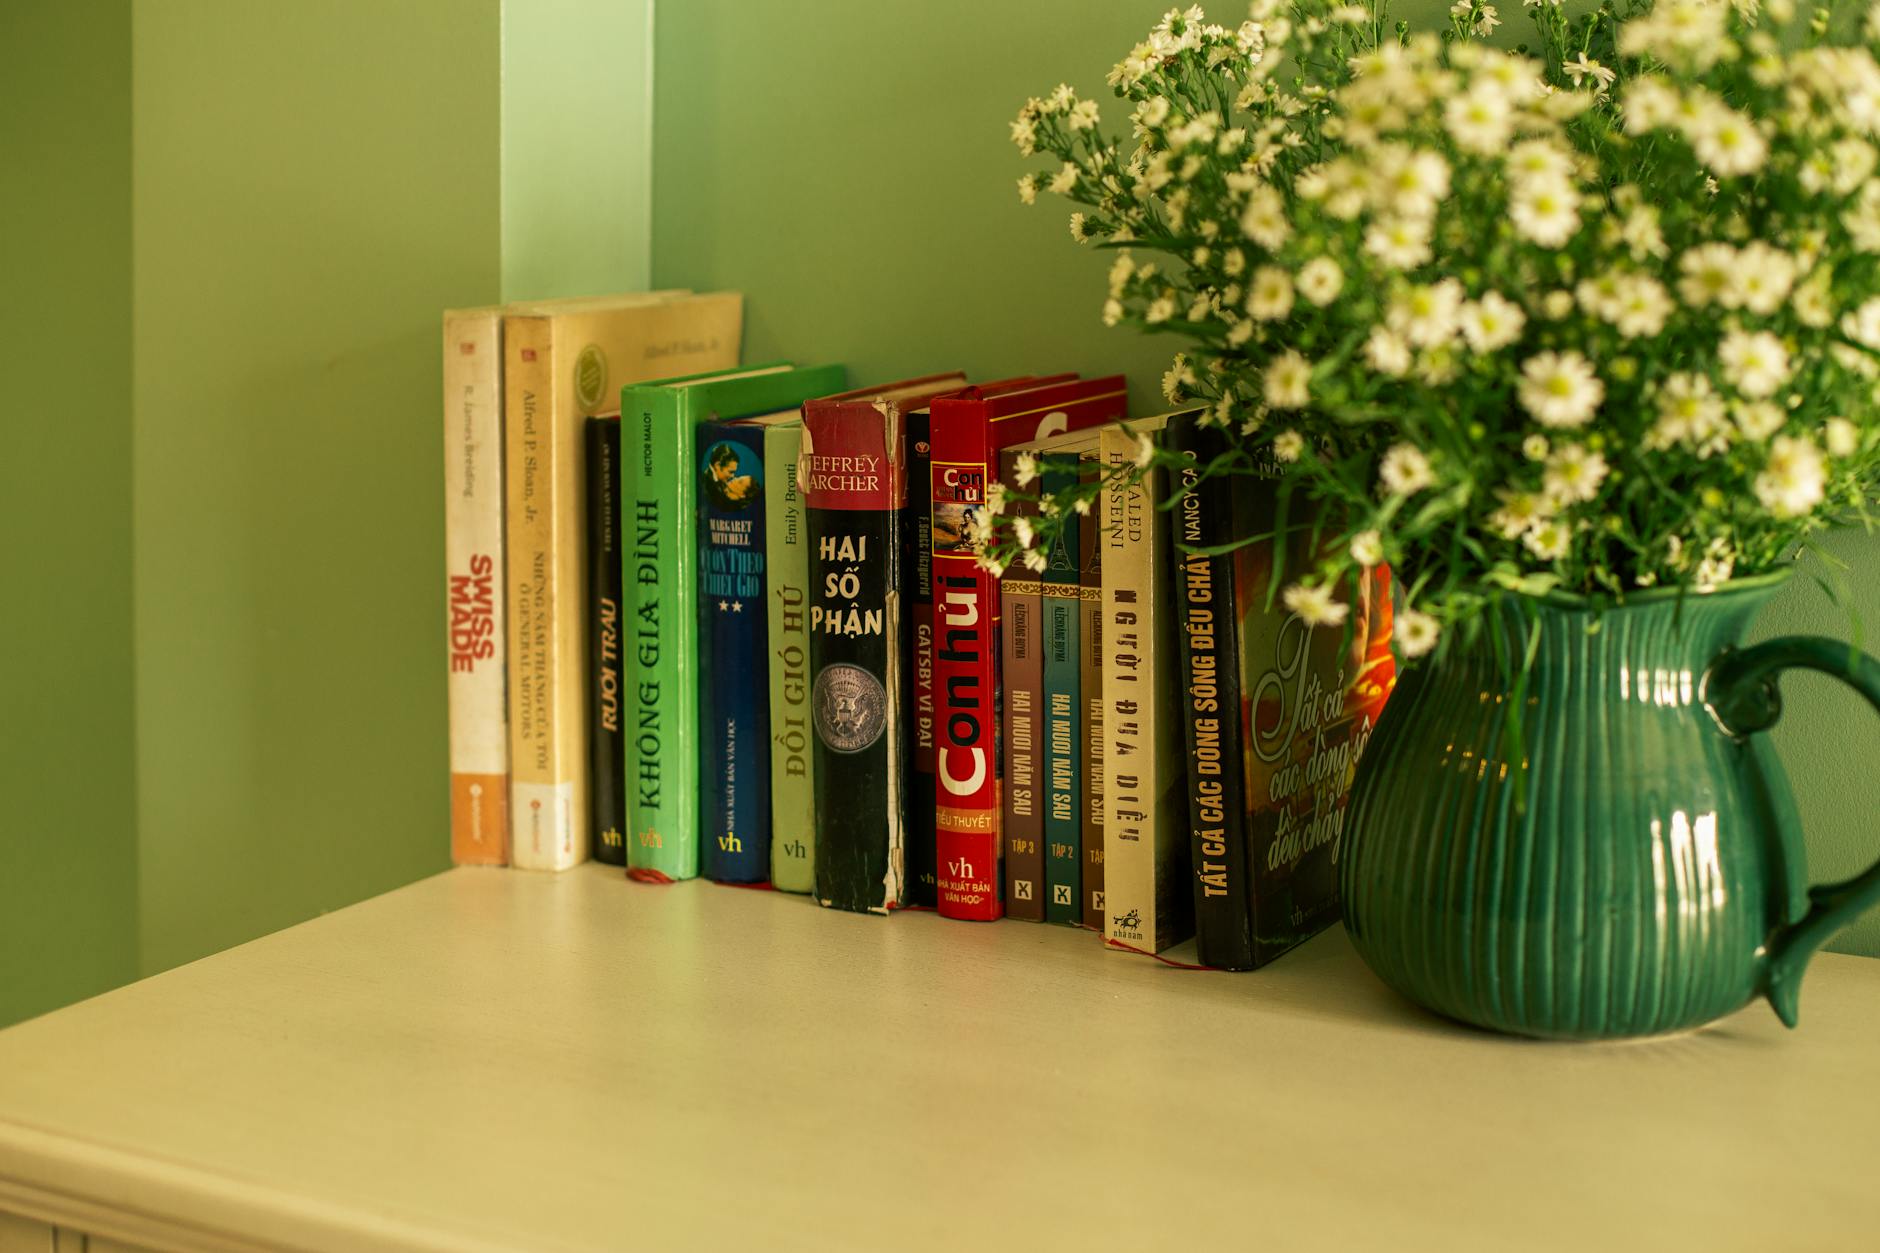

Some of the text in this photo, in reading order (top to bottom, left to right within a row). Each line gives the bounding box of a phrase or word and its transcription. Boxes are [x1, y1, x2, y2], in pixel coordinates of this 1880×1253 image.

[523, 390, 537, 435] Alfred
[524, 440, 537, 453] P.
[643, 412, 652, 477] HECTOR MALOT
[809, 474, 880, 492] ARCHER
[943, 468, 983, 488] Con
[953, 485, 982, 502] hủi
[1110, 451, 1125, 549] HOSSEINI
[1181, 450, 1201, 541] NANCY CAO
[525, 504, 539, 525] Jr.
[709, 518, 753, 533] MARGARET
[784, 507, 800, 545] Emily
[711, 532, 751, 545] MITCHELL
[819, 535, 866, 562] HAI
[825, 565, 861, 599] SỐ
[451, 575, 474, 673] MADE
[470, 554, 494, 660] SWISS
[810, 602, 883, 639] PHẬN
[520, 597, 532, 671] GENERAL
[633, 498, 661, 811] KHÔNG GIA ĐÌNH
[774, 585, 806, 777] ĐỒI GIÓ HÚ
[917, 624, 934, 749] GATSBY VĨ ĐẠI
[937, 575, 986, 796] Con hủi
[519, 675, 532, 740] MOTORS
[1090, 697, 1104, 721] HAI
[1179, 552, 1228, 898] TẤT CẢ CÁC DÒNG SÔNG ĐỀU CHẢY
[1012, 690, 1034, 817] HAI MƯƠI NĂM SAU
[1052, 693, 1074, 821] HAI MƯƠI NĂM SAU
[1268, 714, 1375, 804] các dòng sô
[936, 811, 992, 829] TIỂU THUYẾT
[1090, 798, 1105, 826] SAU
[717, 831, 743, 854] vh
[1012, 838, 1035, 856] TẬP 3
[1267, 791, 1347, 872] đều chảy
[784, 840, 806, 859] vh
[1051, 842, 1074, 860] TẬP 2
[1090, 849, 1105, 865] TẬP
[948, 857, 974, 879] vh
[950, 878, 971, 892] XUẤT
[972, 878, 991, 893] BẢN
[960, 893, 981, 905] HỌC
